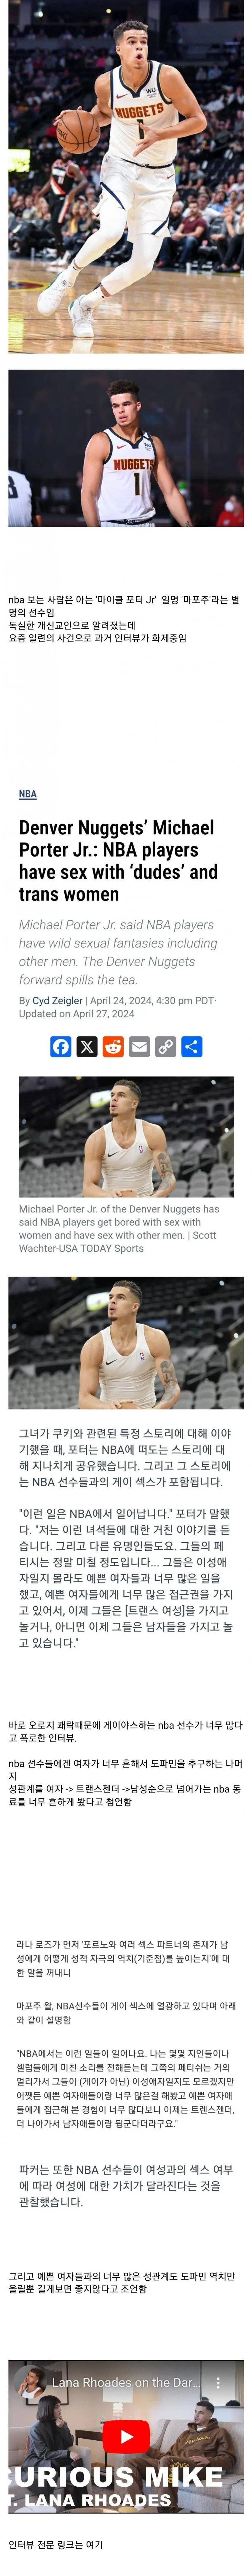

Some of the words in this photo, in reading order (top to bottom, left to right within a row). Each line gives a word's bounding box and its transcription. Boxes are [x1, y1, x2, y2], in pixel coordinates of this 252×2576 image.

[114, 102, 164, 118] NUGGETS
[137, 119, 145, 139] 1
[113, 459, 154, 470] NUGGETS
[134, 473, 140, 495] 1
